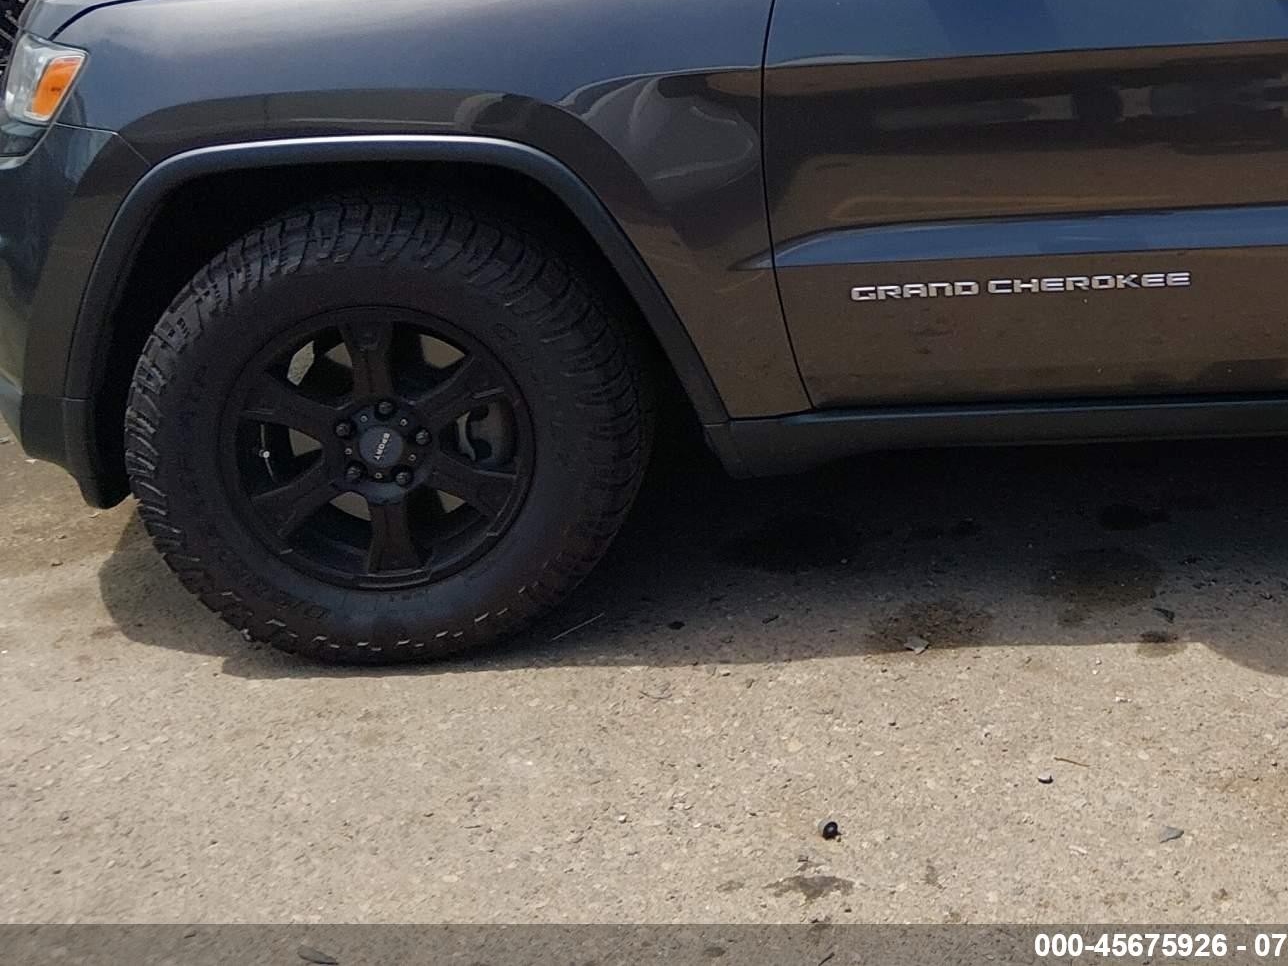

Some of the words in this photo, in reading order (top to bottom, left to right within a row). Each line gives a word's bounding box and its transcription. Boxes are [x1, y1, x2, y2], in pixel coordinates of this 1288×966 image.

[851, 281, 980, 301] GRAND
[987, 272, 1191, 294] CHEROKEE
[373, 432, 391, 461] SPORT
